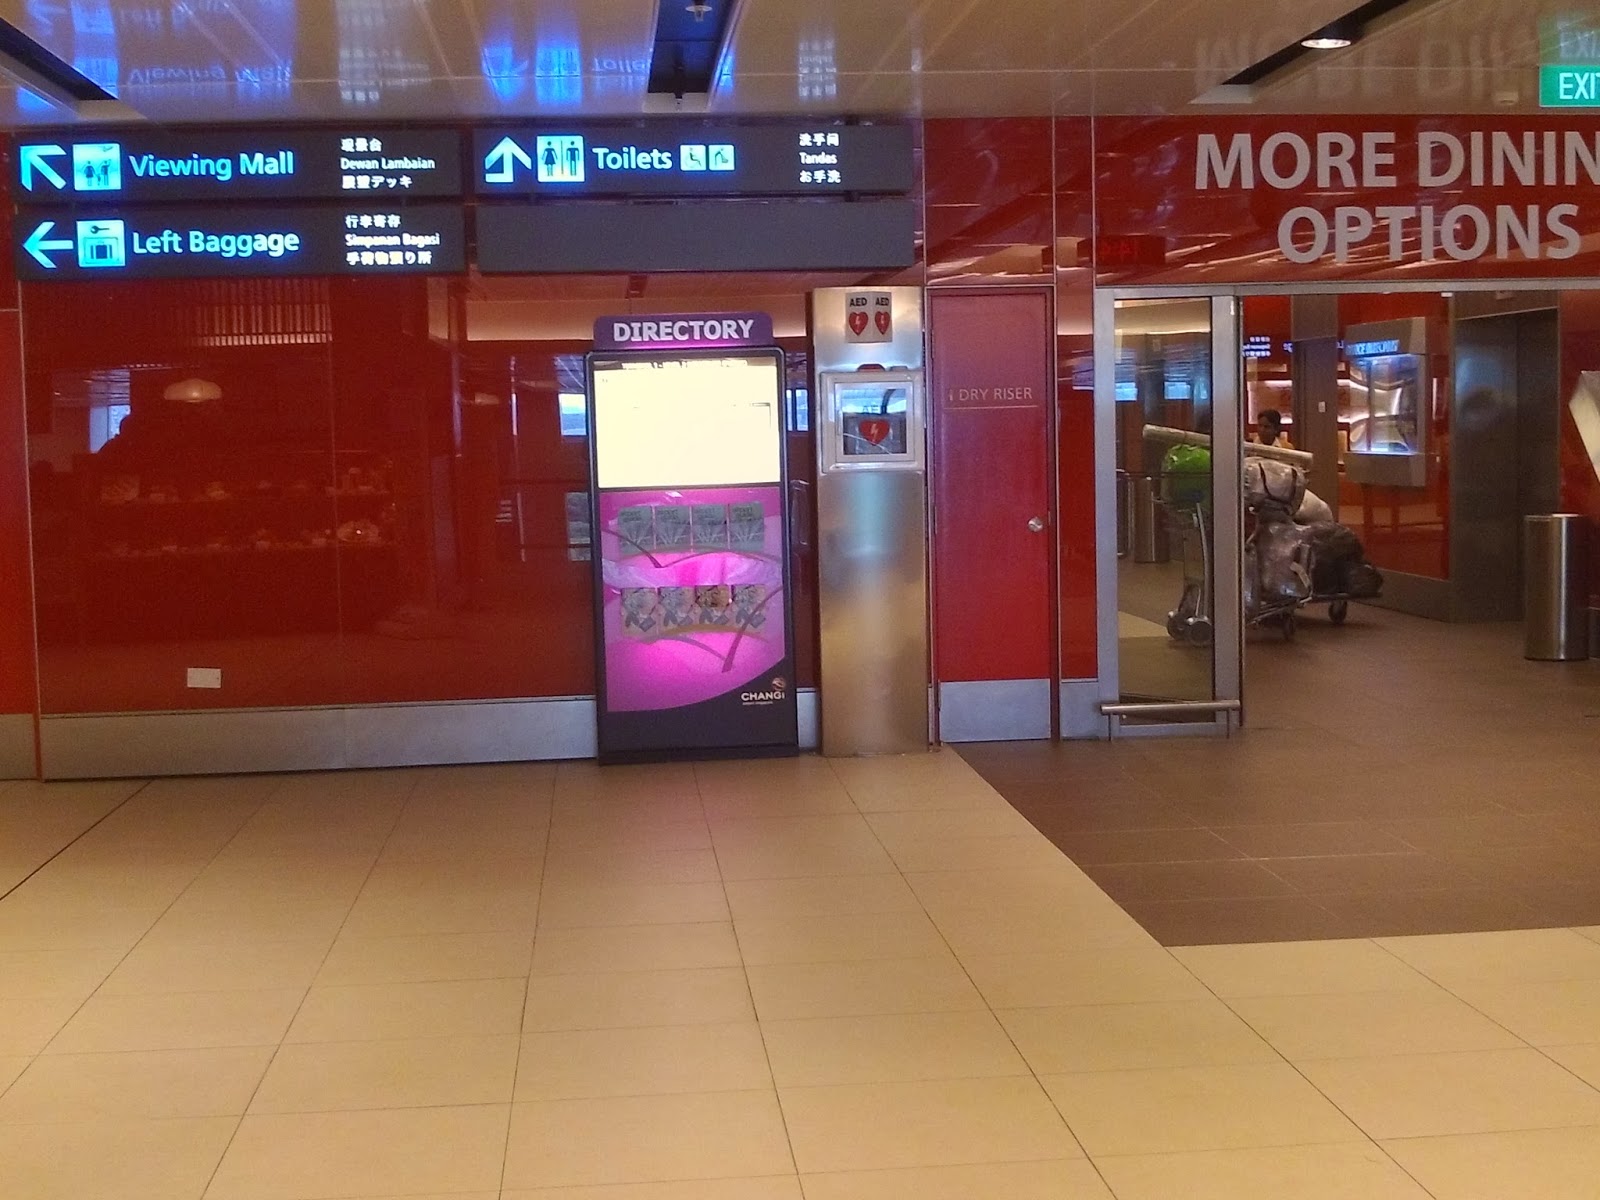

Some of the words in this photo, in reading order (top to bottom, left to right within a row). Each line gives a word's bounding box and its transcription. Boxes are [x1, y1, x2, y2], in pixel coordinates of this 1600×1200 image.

[1559, 72, 1600, 100] EXI
[129, 153, 232, 181] Viewing
[239, 150, 294, 175] Mall
[340, 157, 379, 170] Dewan
[381, 156, 436, 170] Lambaian
[592, 146, 673, 170] Toilets
[799, 151, 838, 165] Tandas
[1195, 131, 1398, 190] MORE
[799, 169, 842, 184] お手洗
[1277, 203, 1582, 264] OPTIONS
[133, 229, 184, 254] Left
[188, 230, 300, 258] Baggage
[850, 297, 868, 308] AED
[875, 297, 890, 307] AED
[613, 319, 754, 342] DIRECTORY
[959, 388, 989, 401] DRY
[993, 387, 1032, 400] RISER
[740, 691, 785, 702] CHANGI
